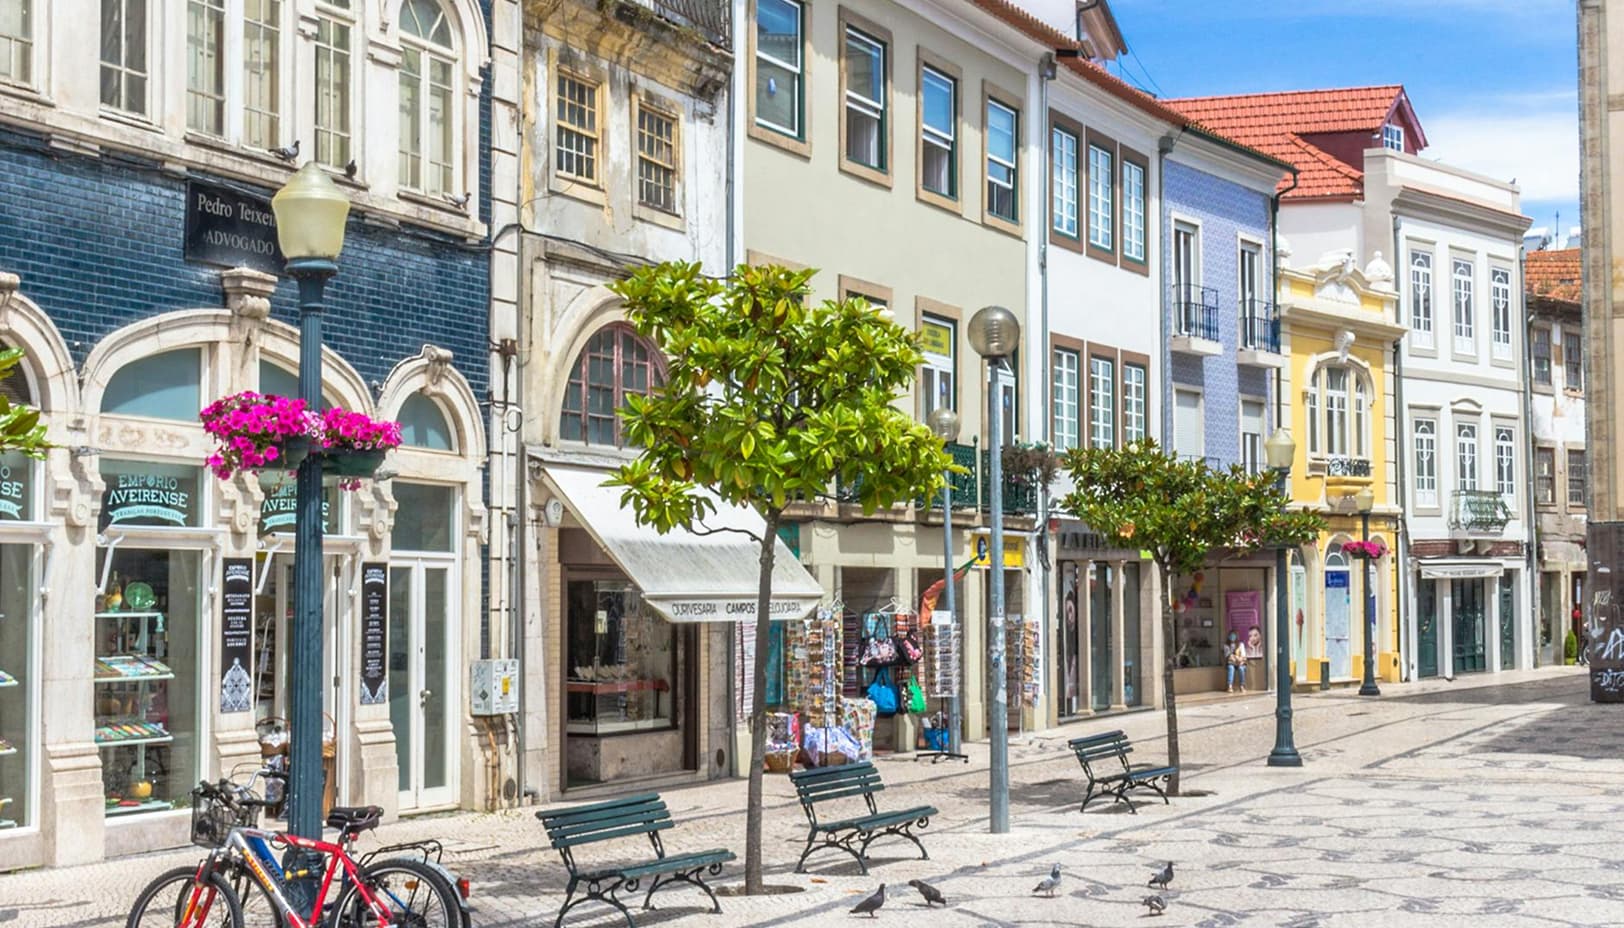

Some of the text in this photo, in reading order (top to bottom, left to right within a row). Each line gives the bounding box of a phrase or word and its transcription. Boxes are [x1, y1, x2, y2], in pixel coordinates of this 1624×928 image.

[197, 193, 233, 218] Pedro
[206, 229, 274, 255] ADVOGADO
[108, 489, 188, 508] AVEIRENSE
[725, 602, 756, 615] CAMPOS
